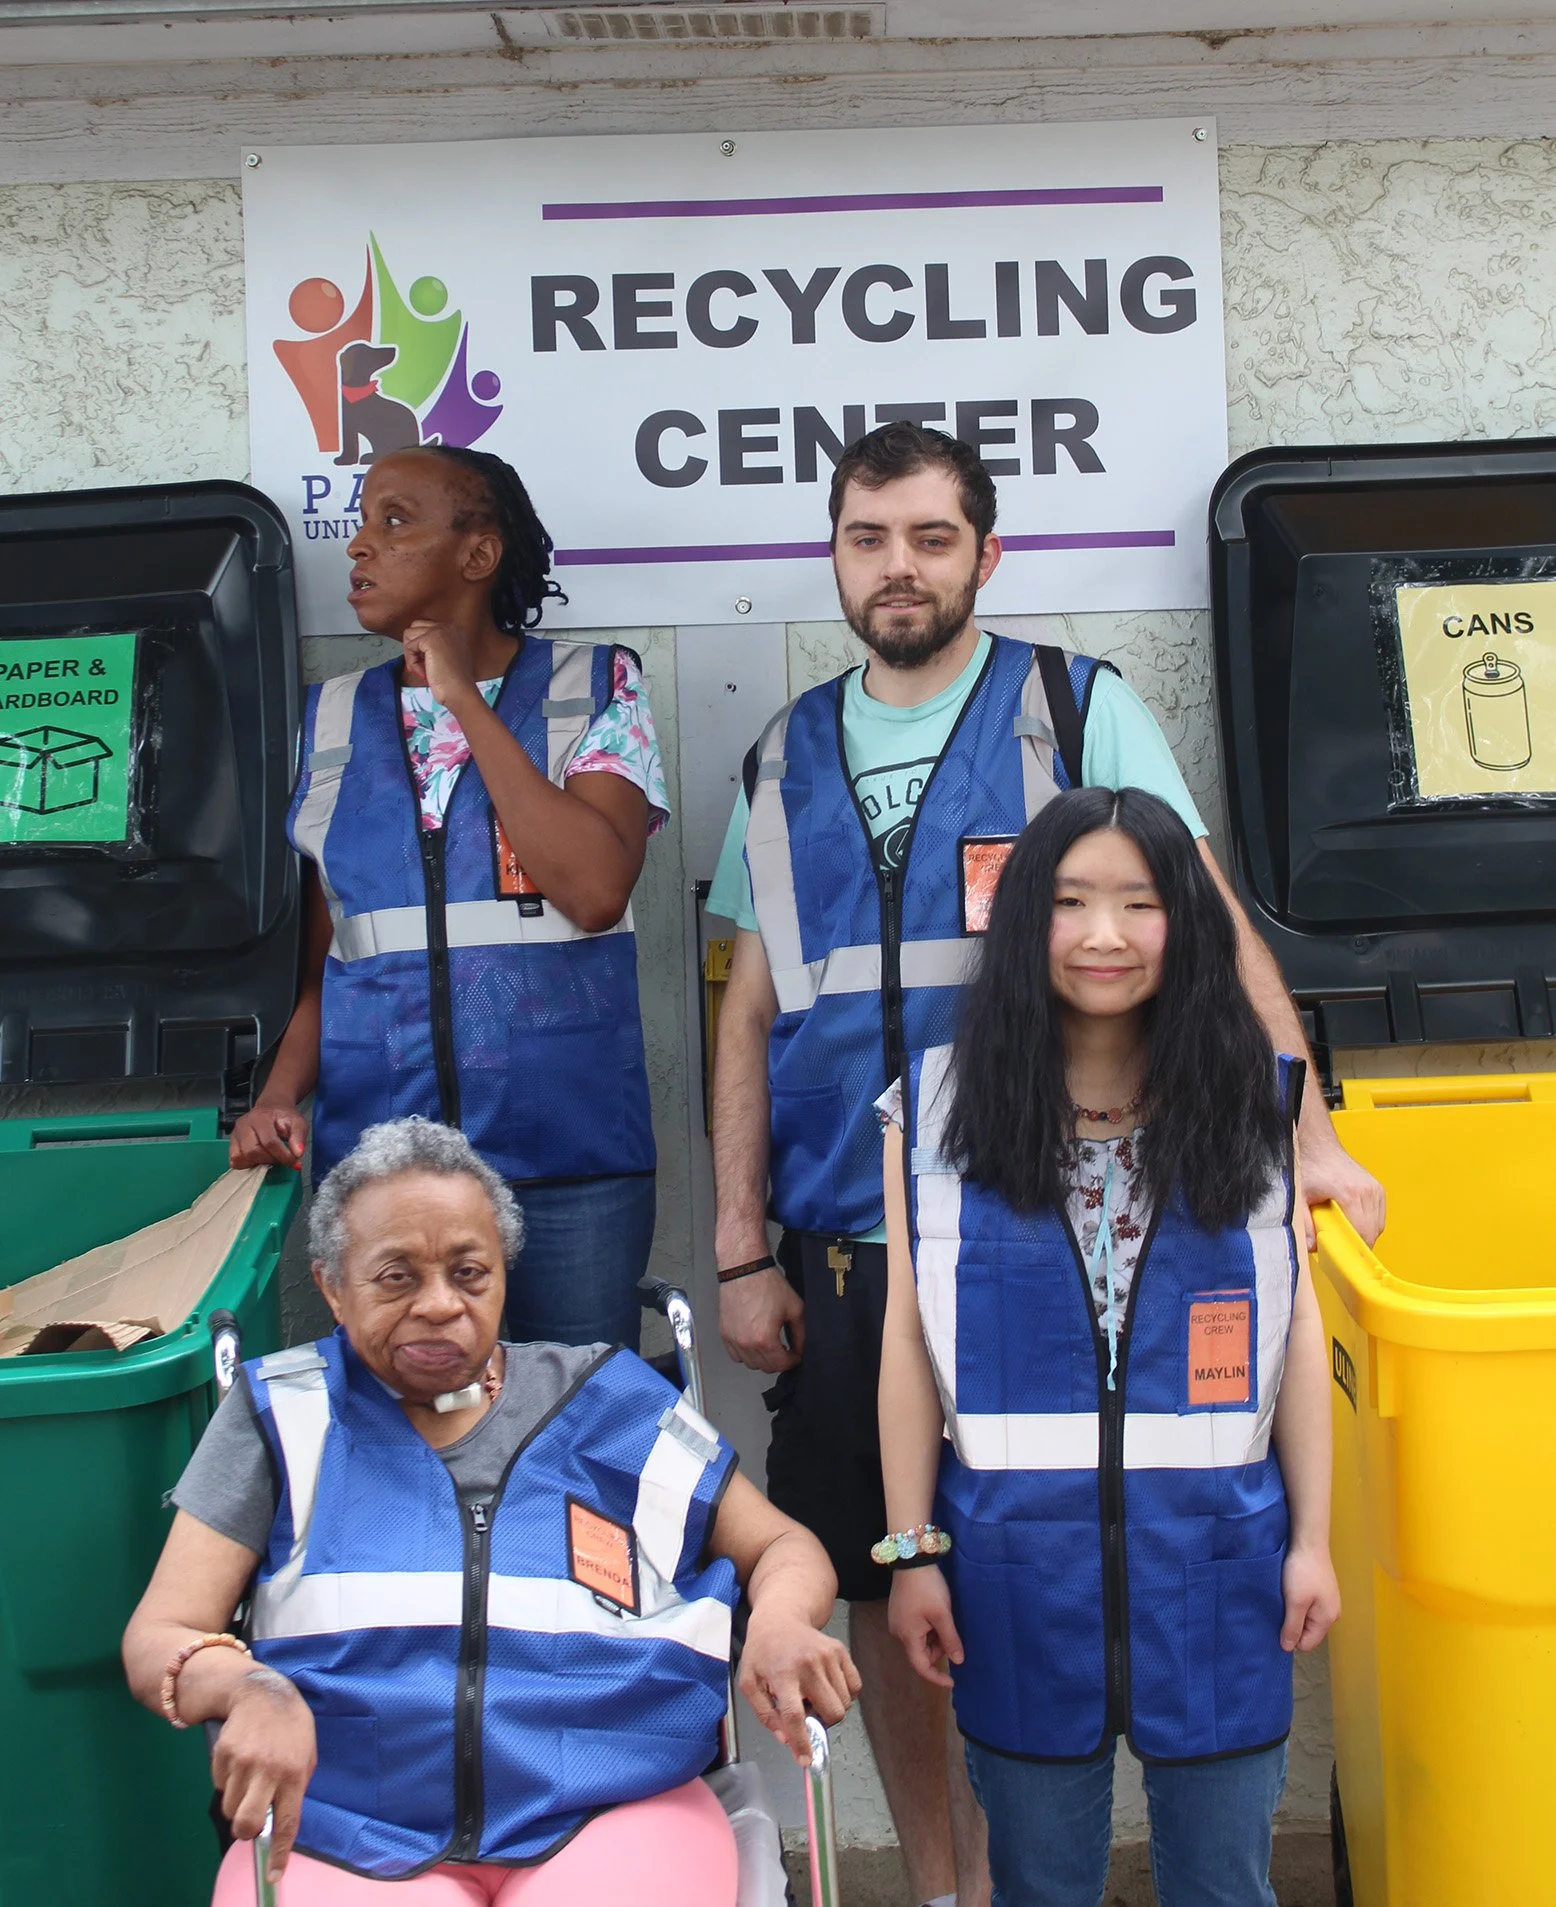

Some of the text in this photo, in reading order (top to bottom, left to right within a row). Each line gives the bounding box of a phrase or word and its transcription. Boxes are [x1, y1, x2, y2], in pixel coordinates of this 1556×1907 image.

[531, 256, 1197, 353] RECYCLING
[303, 519, 365, 540] UNIV
[1442, 612, 1534, 639] CANS
[88, 658, 107, 677] &
[0, 689, 119, 710] RDBOARD
[860, 778, 923, 820] OLC
[1191, 1311, 1247, 1324] RECYCLING
[1204, 1325, 1234, 1336] CREW
[1195, 1366, 1246, 1381] MAYLIN
[577, 1555, 631, 1587] BRENDA
